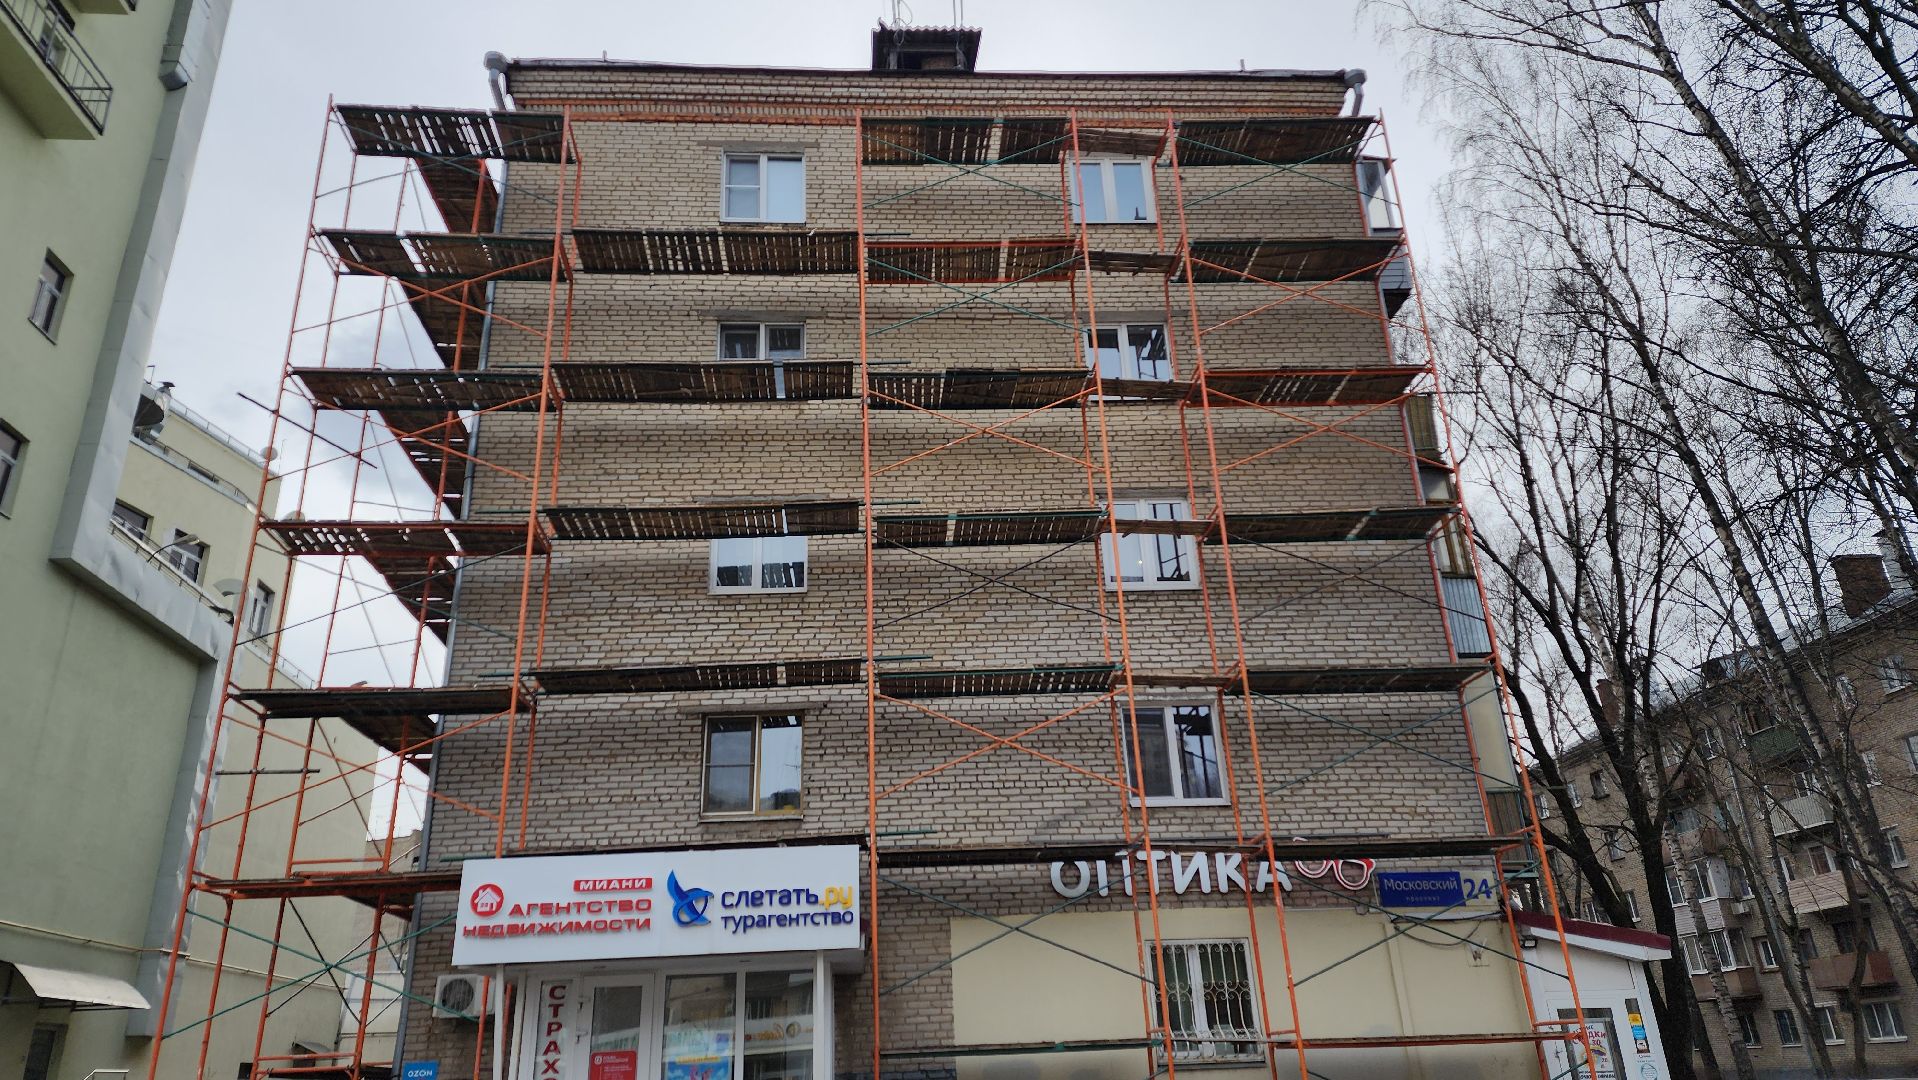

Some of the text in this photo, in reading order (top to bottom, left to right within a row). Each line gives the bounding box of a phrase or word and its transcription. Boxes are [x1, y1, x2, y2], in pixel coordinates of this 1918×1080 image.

[1051, 850, 1293, 898] ОПТИКА
[579, 878, 648, 891] МИАНИ
[1384, 878, 1458, 891] Московский
[1464, 878, 1492, 899] 24
[508, 898, 652, 917] АГЕНТСТВО
[721, 886, 853, 910] слетать.ру
[463, 918, 651, 938] НЕДВИЖИМОСТИ
[720, 910, 854, 934] турагентство
[407, 1070, 433, 1078] OZON
